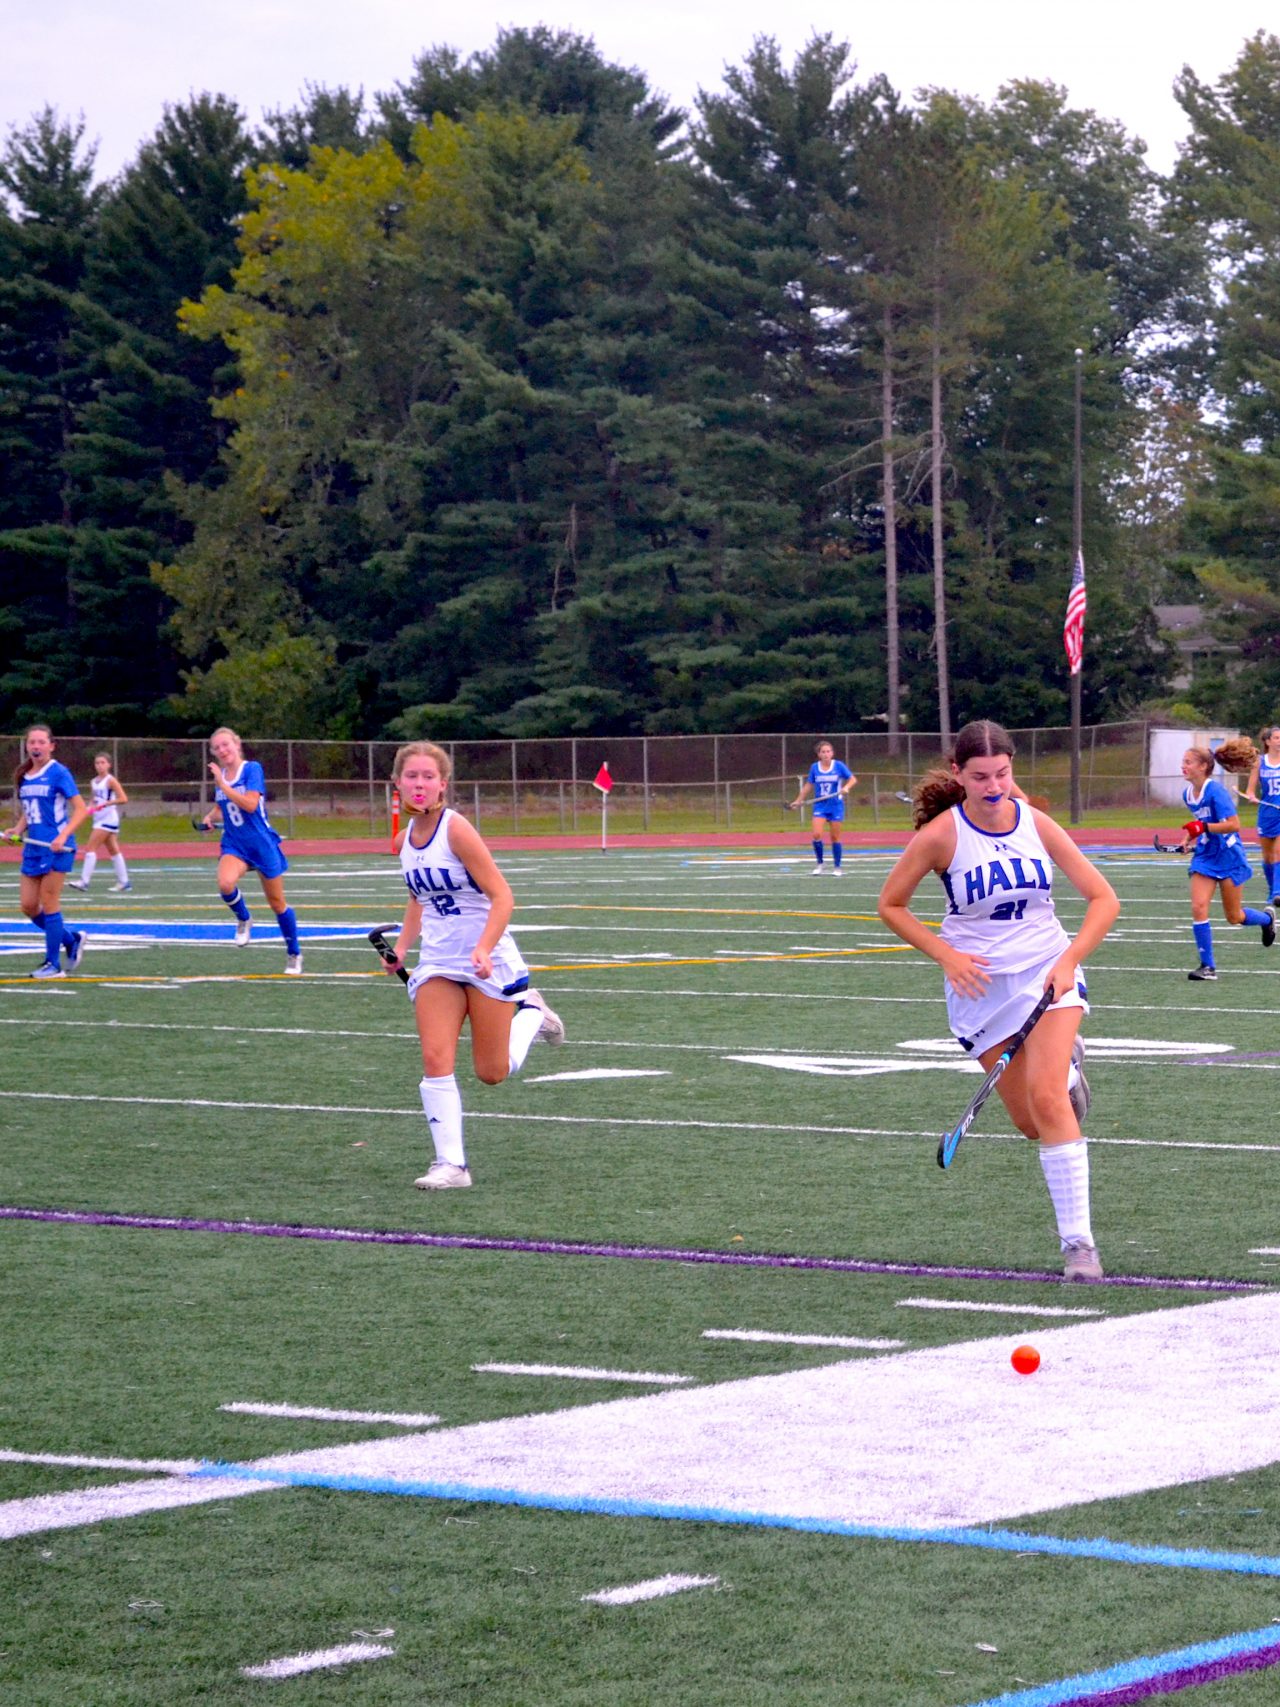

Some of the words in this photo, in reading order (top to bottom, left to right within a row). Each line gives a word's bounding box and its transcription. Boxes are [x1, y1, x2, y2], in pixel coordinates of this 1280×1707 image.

[226, 801, 244, 827] 8
[964, 858, 1051, 905] HALL
[990, 899, 1027, 920] 21
[374, 938, 396, 959] TK
